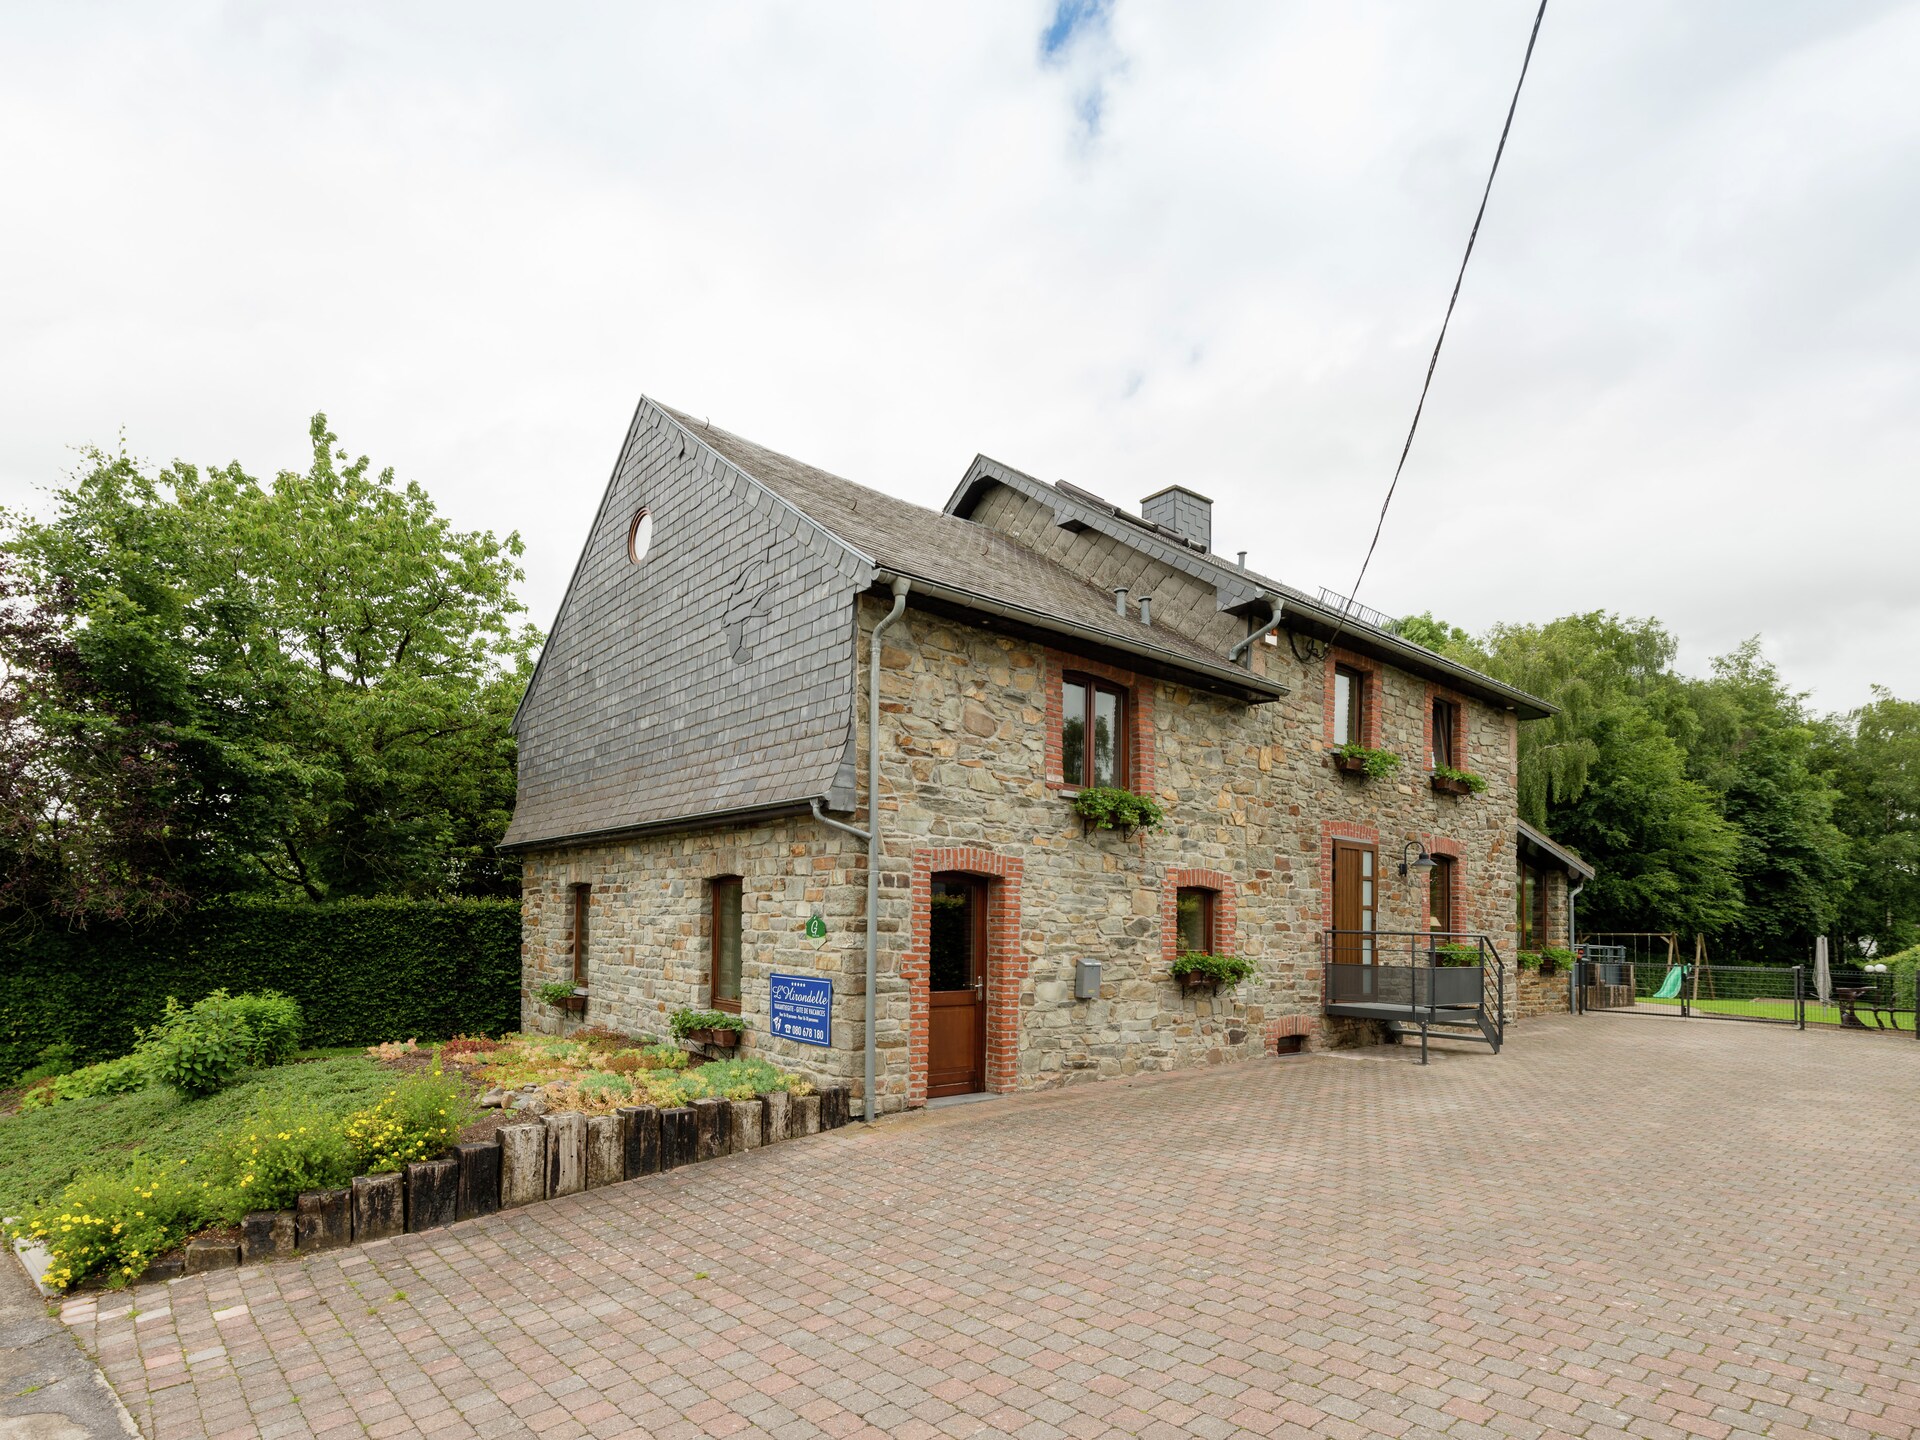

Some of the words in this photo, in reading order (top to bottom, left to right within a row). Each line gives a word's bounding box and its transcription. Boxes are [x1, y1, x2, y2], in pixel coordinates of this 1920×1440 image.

[772, 985, 828, 1005] L'Hirondelle
[792, 1025, 802, 1036] 080
[802, 1027, 812, 1038] 678
[814, 1029, 824, 1040] 180
